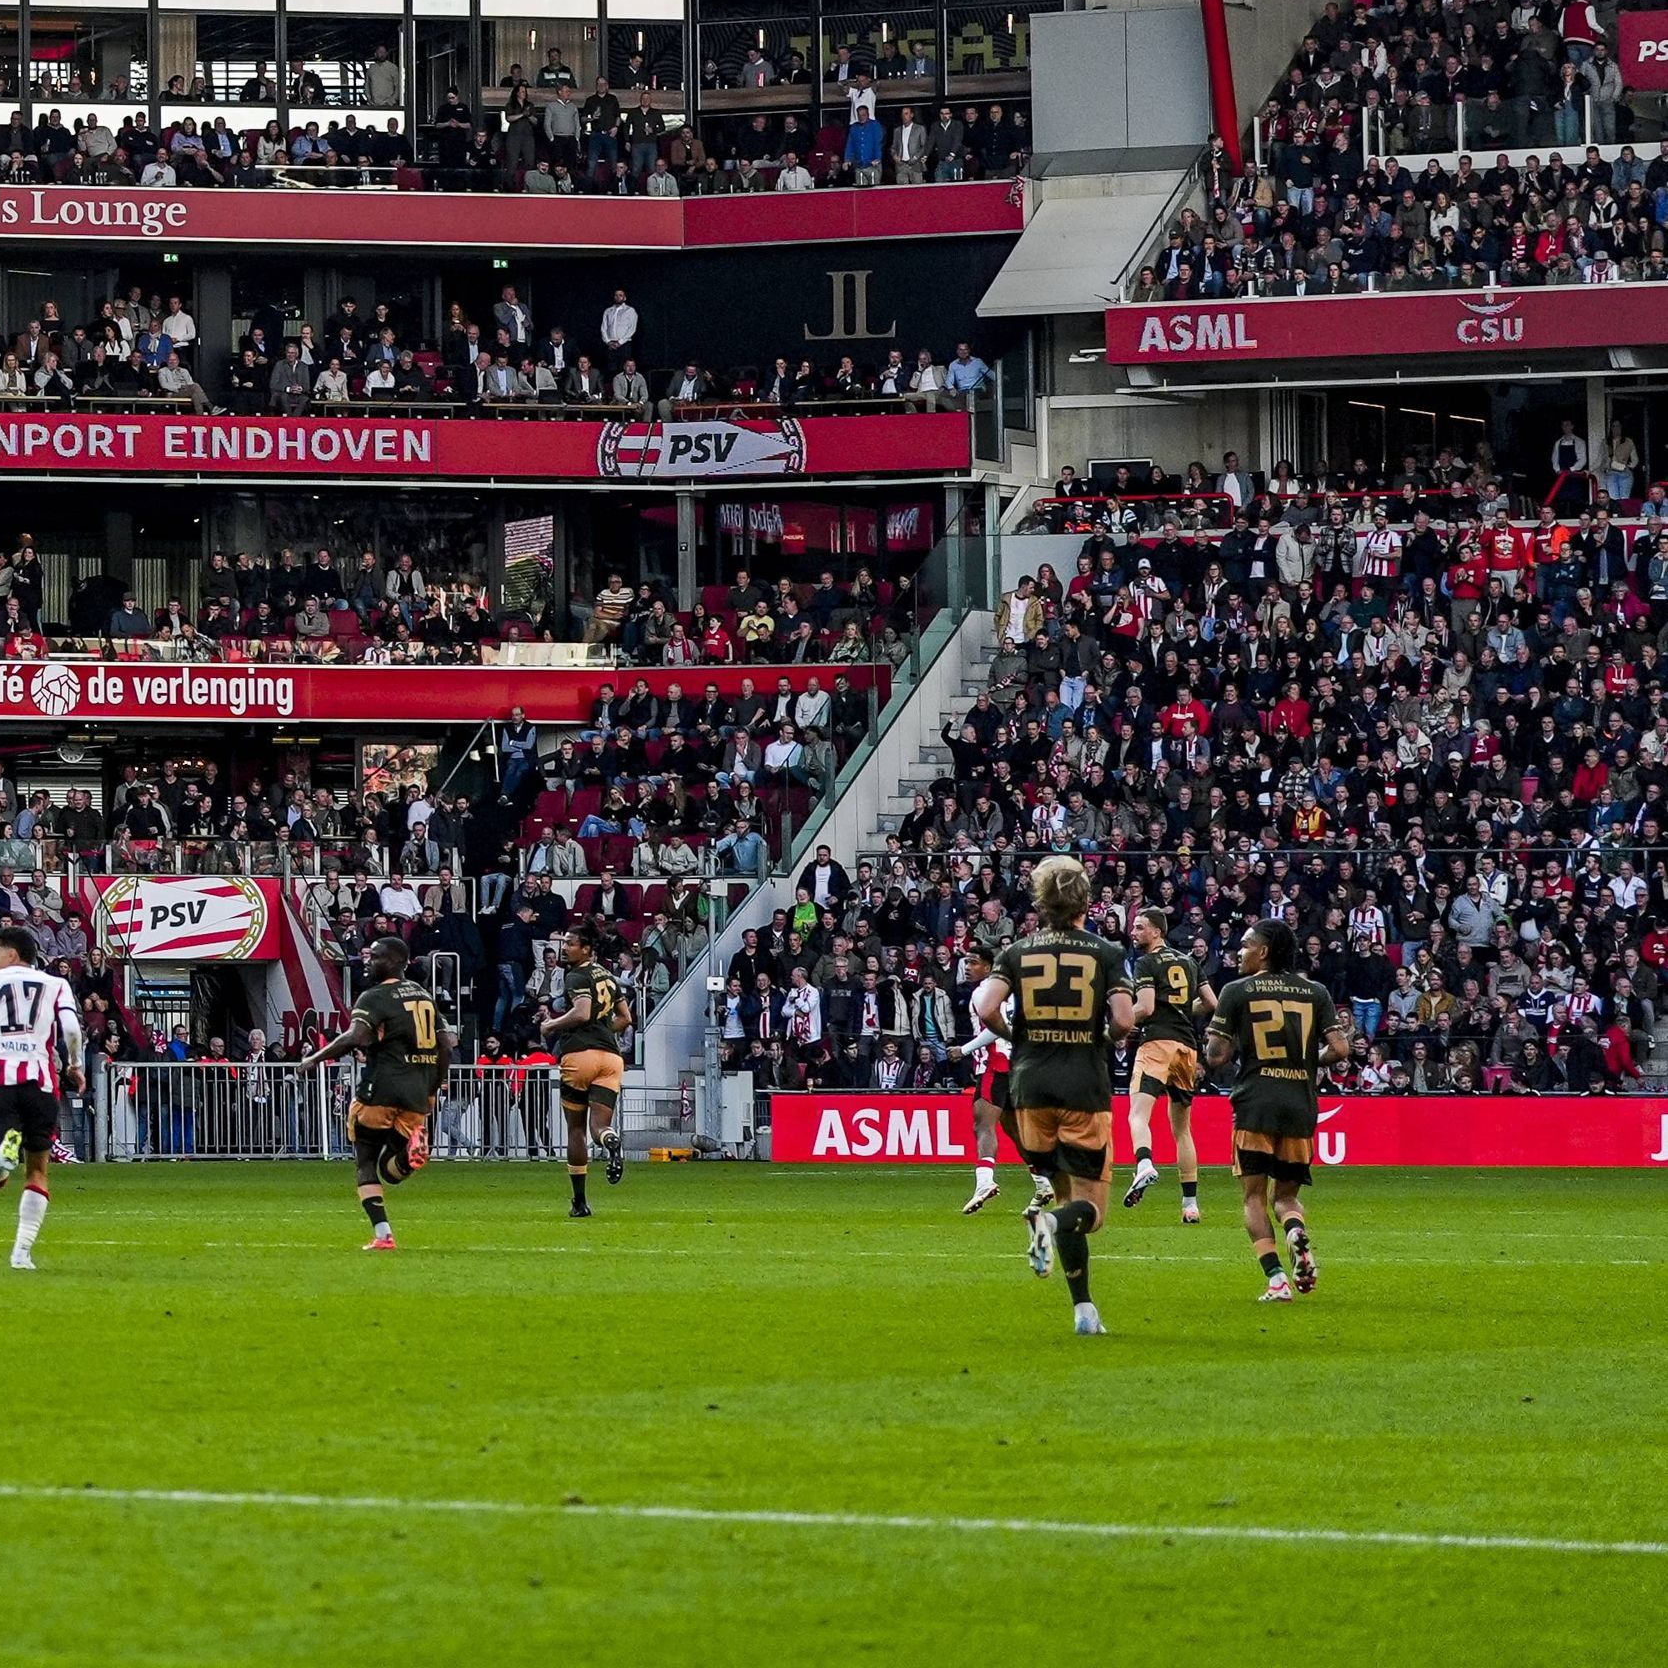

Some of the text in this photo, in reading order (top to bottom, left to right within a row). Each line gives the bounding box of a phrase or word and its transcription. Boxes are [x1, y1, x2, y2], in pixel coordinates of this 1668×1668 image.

[32, 190, 187, 236] Lounge
[1138, 313, 1258, 353] ASML
[1456, 317, 1524, 344] CSU
[164, 425, 432, 463] EINDHOVEN
[668, 433, 739, 465] PSV
[88, 666, 123, 705] de
[133, 668, 294, 716] verlenging
[149, 898, 209, 932] PSV
[1021, 953, 1097, 1021] 23
[1168, 965, 1189, 1005] 9
[403, 1000, 437, 1049] 10
[1249, 999, 1313, 1061] 27
[813, 1108, 966, 1157] ASML
